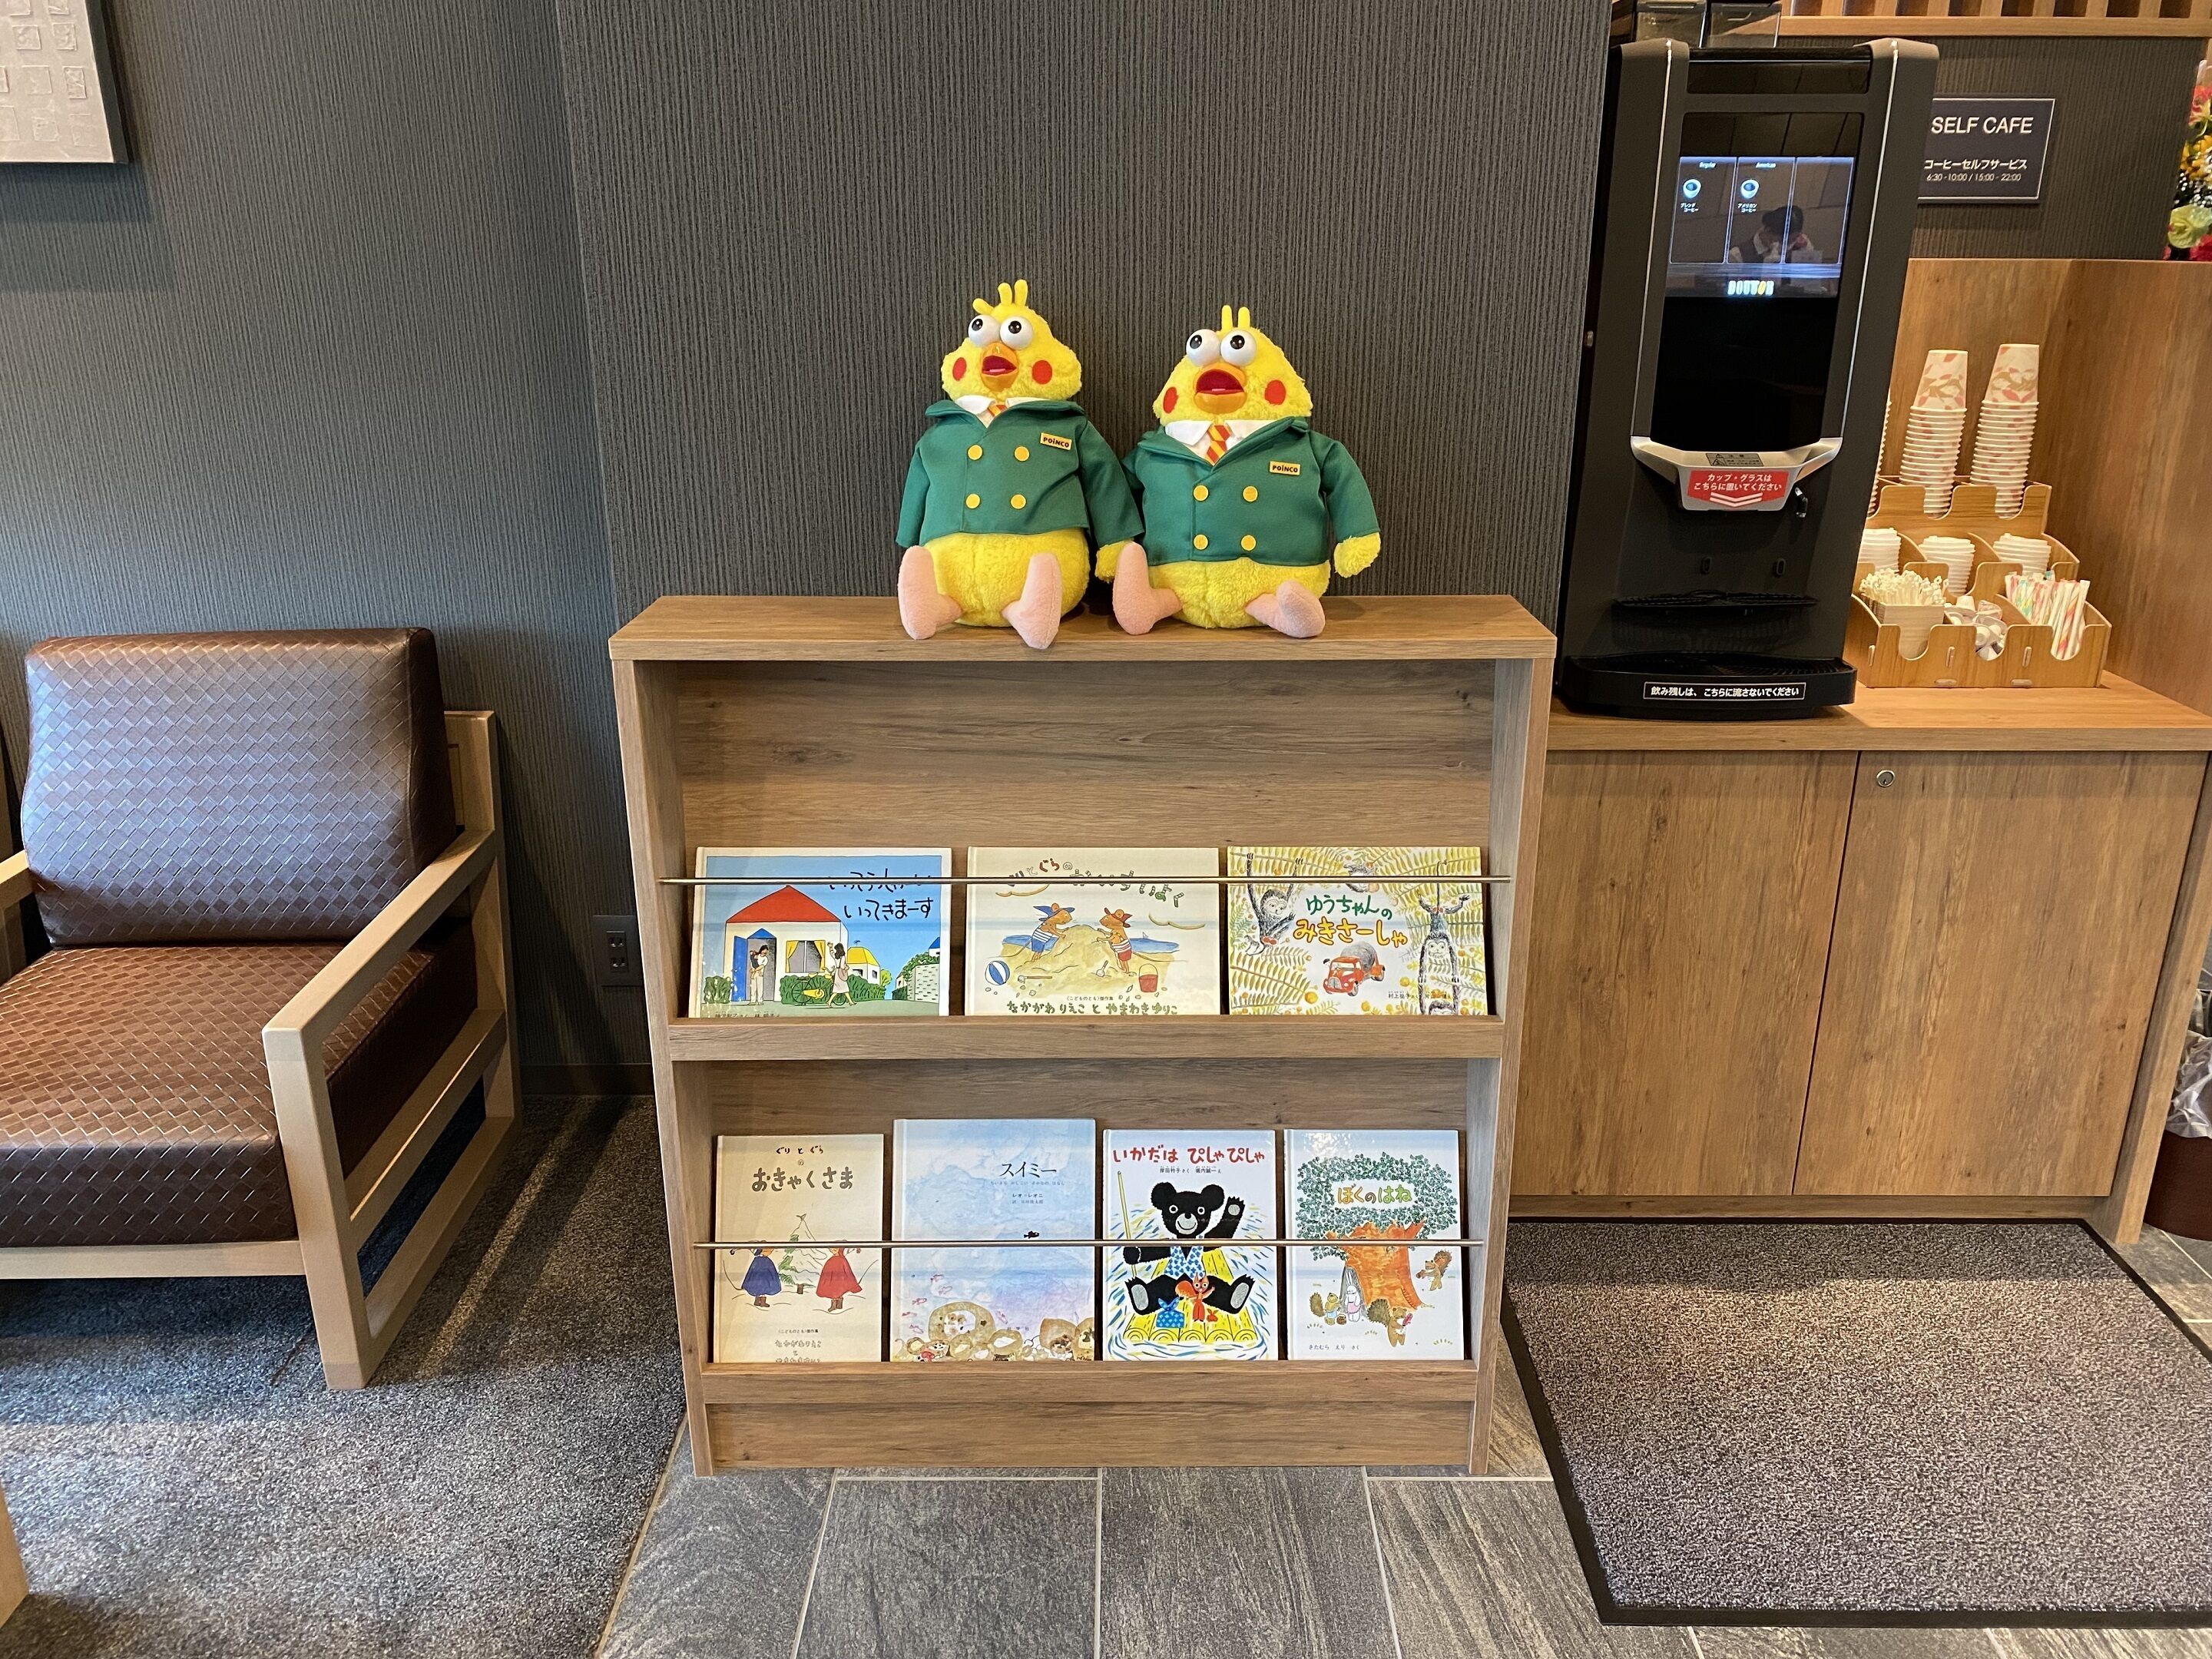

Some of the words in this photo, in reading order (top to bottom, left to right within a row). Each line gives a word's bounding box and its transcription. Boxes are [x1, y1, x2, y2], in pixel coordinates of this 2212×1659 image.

[1931, 116, 1979, 134] SELF
[1983, 116, 2034, 134] CAFE
[1924, 159, 2028, 170] コーヒーセルフサービス
[1694, 482, 1782, 491] こちらに置いてください
[844, 897, 934, 921] いってきまーす
[1305, 894, 1393, 920] ゆうちゃんの
[1293, 916, 1409, 949] みきさーしゃ
[751, 1166, 853, 1192] おきゃくさま
[999, 1161, 1058, 1178] スイミー
[1337, 1183, 1412, 1204] ぼくのはね
